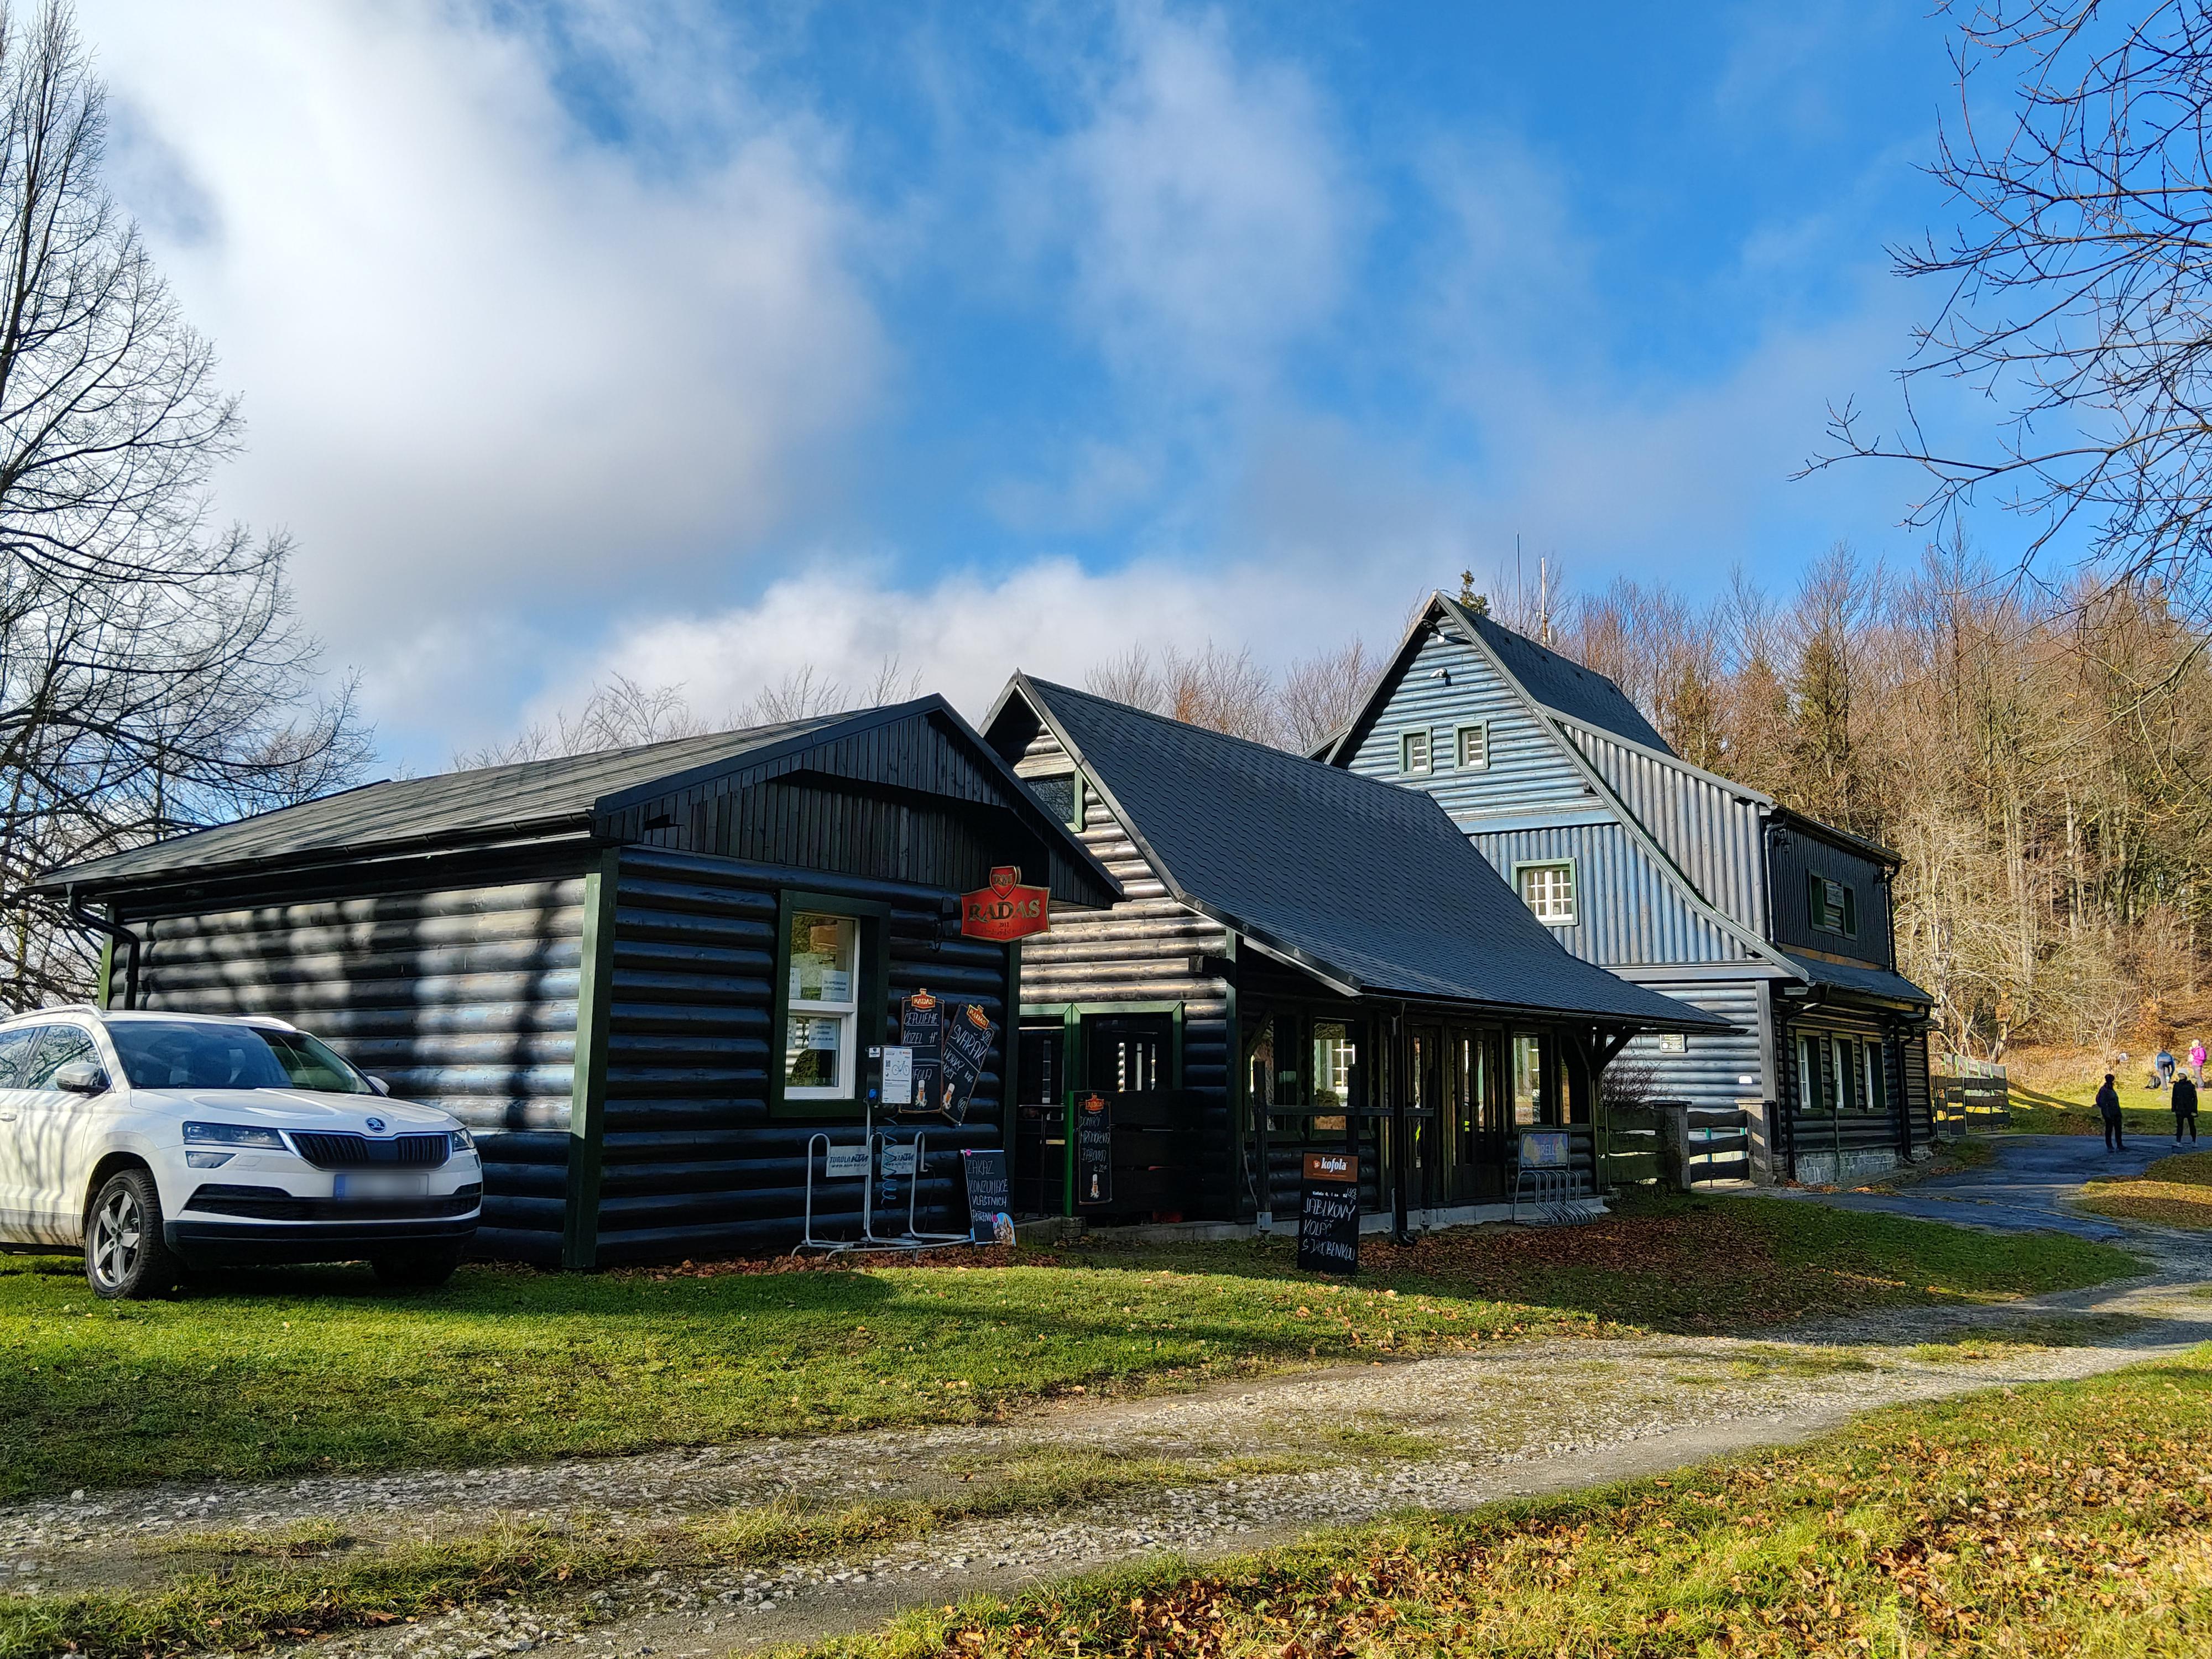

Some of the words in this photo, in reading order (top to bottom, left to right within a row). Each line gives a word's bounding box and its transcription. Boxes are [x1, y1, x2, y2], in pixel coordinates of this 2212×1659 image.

[968, 898, 1041, 923] RADAS
[913, 997, 933, 1005] RADAS
[968, 1009, 989, 1026] RADAS
[902, 1030, 923, 1045] KOZEL
[851, 1154, 869, 1162] KTM
[1321, 1156, 1347, 1172] kofola
[969, 1178, 1009, 1195] KONZUMACE
[1303, 1197, 1356, 1222] JABLKOVÝ
[1303, 1219, 1334, 1237] KOLÁČ
